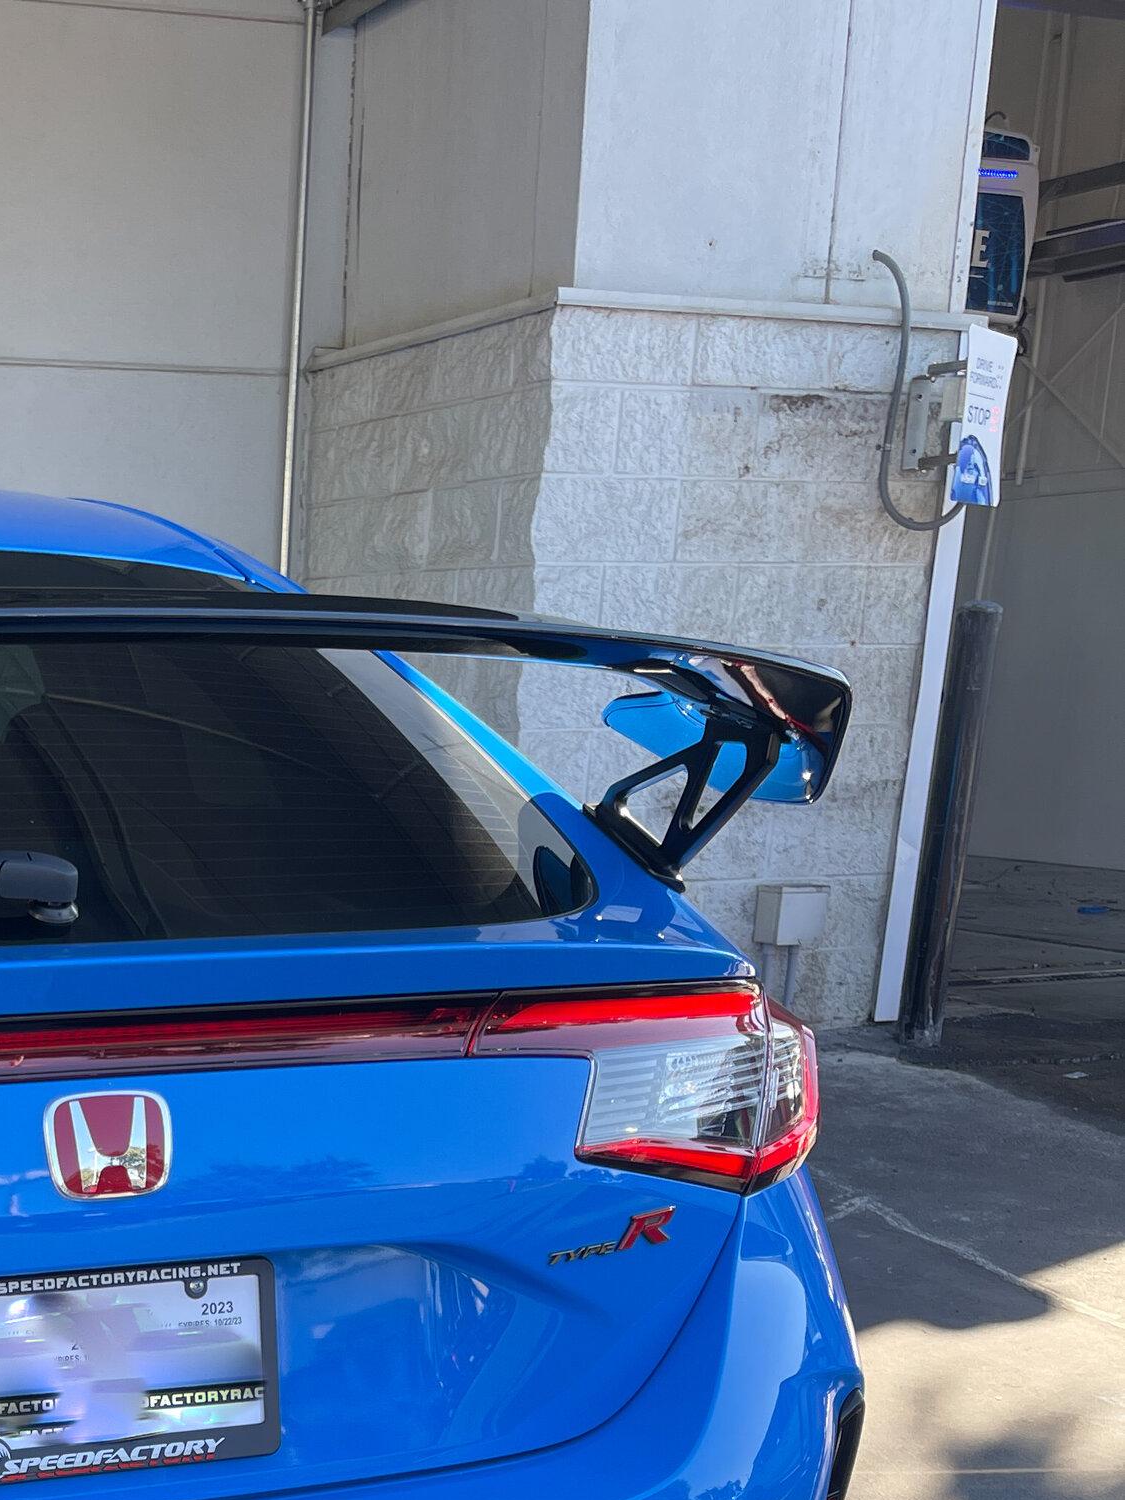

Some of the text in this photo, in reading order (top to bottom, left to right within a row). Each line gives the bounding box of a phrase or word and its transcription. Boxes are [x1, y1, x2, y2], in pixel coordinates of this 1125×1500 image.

[967, 405, 991, 426] STOP
[547, 1204, 677, 1266] TYPE R
[201, 1301, 234, 1316] 2023
[214, 1317, 242, 1326] 10/22/23
[3, 1437, 226, 1476] SPEEDFACTORY
